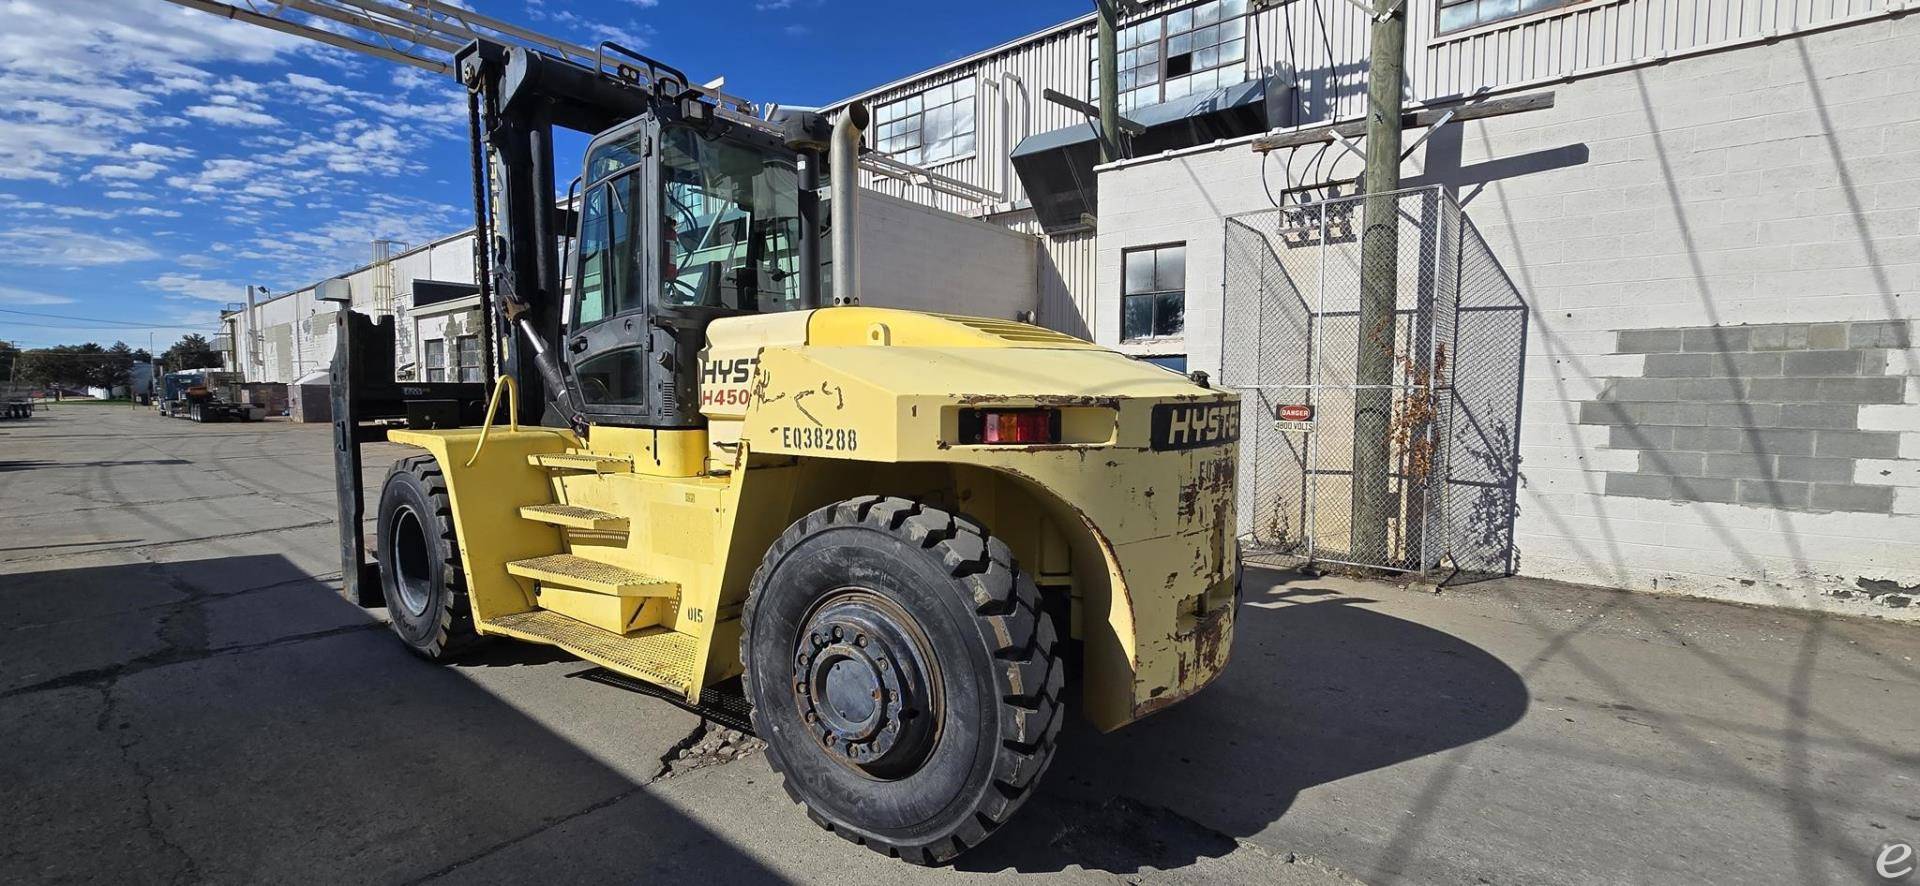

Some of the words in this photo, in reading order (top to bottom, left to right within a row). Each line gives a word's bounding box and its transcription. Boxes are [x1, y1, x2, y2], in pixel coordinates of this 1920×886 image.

[703, 389, 750, 406] H450
[1281, 409, 1309, 417] DANGER
[1275, 421, 1293, 430] 4800
[1294, 422, 1314, 431] VOLTS
[783, 427, 857, 451] EQ38288
